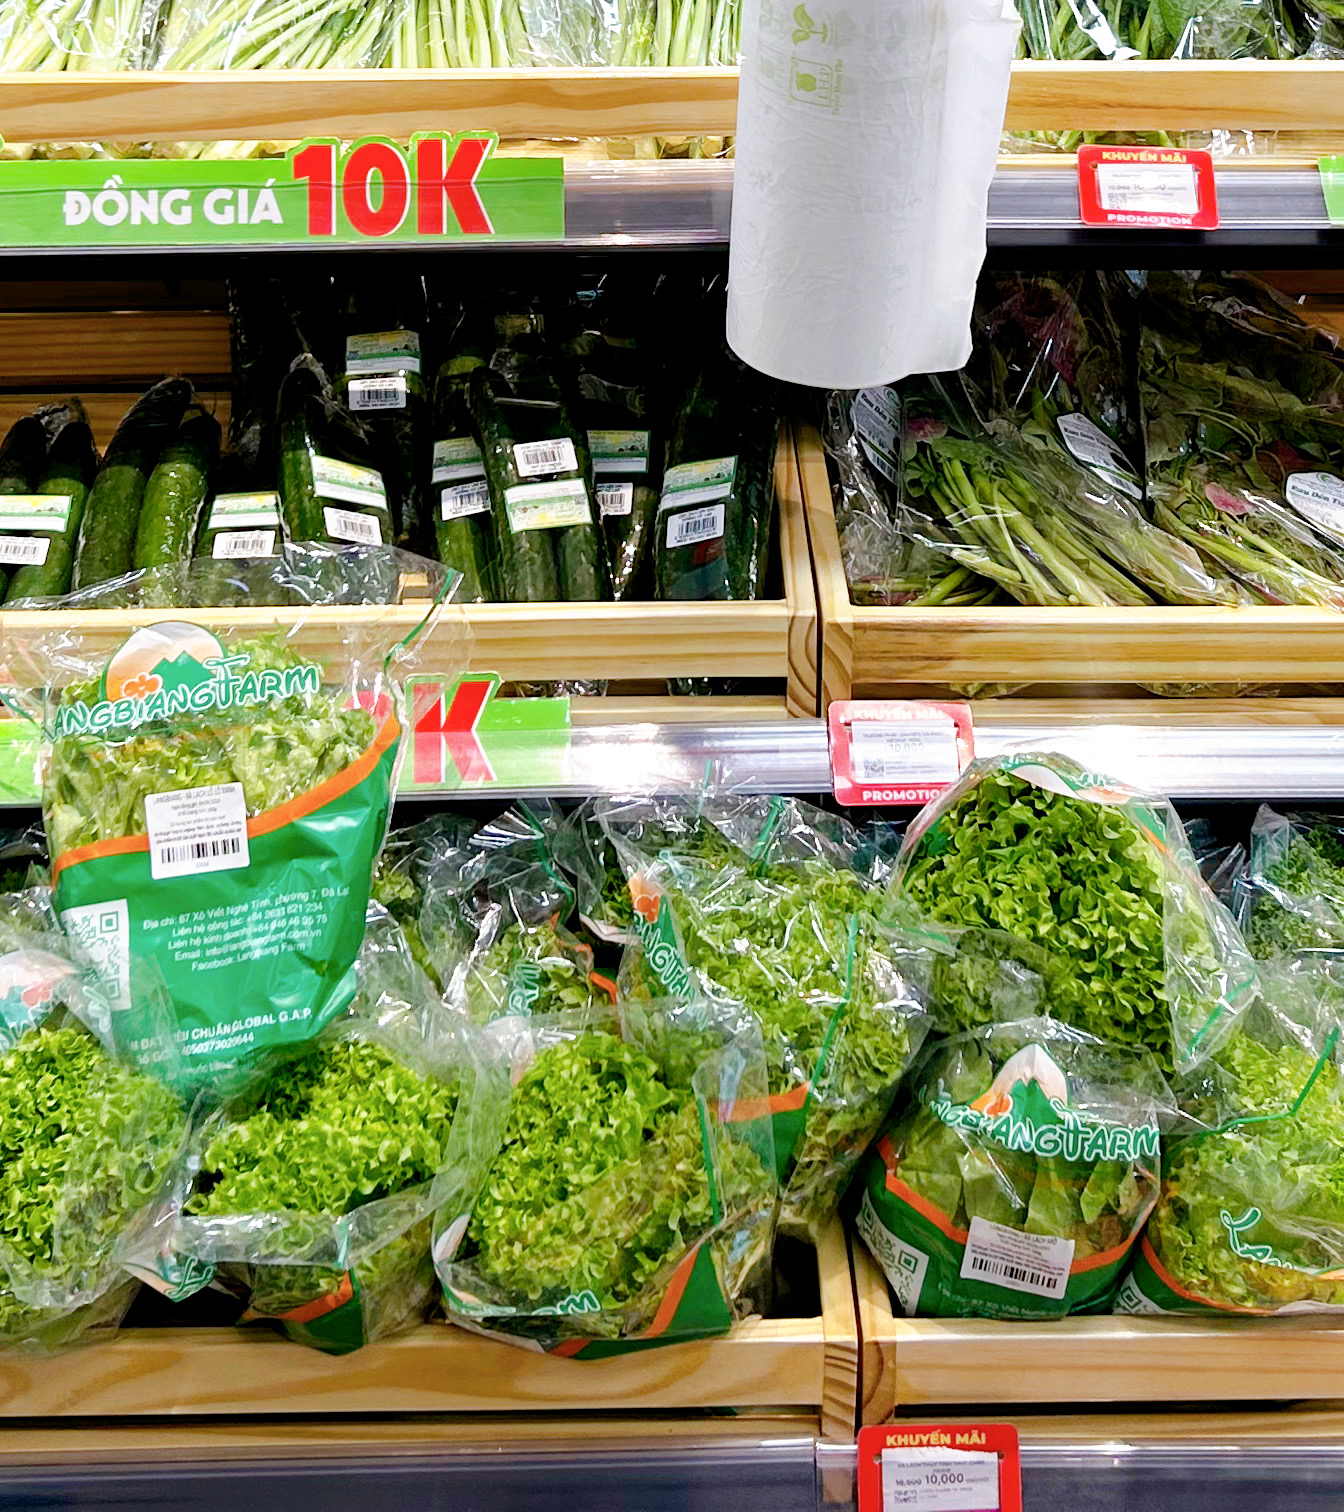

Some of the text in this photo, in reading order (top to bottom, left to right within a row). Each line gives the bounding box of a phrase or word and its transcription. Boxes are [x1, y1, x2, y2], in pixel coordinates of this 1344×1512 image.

[1101, 149, 1187, 164] KHUYẾN MÃI
[63, 174, 193, 227] ĐỒNG
[202, 178, 284, 225] GIÁ
[292, 138, 497, 236] 10K
[1106, 213, 1193, 226] PROMOTION
[202, 653, 321, 710] FARM
[861, 788, 943, 801] PROMOTIO
[171, 925, 192, 938] Liên
[305, 901, 323, 913] 234
[167, 939, 189, 951] Liên
[191, 1021, 231, 1041] CHUẨN
[231, 1012, 277, 1034] GLOBAL
[885, 1428, 986, 1447] KHUYẾN MÃI
[924, 1473, 965, 1486] 10,000
